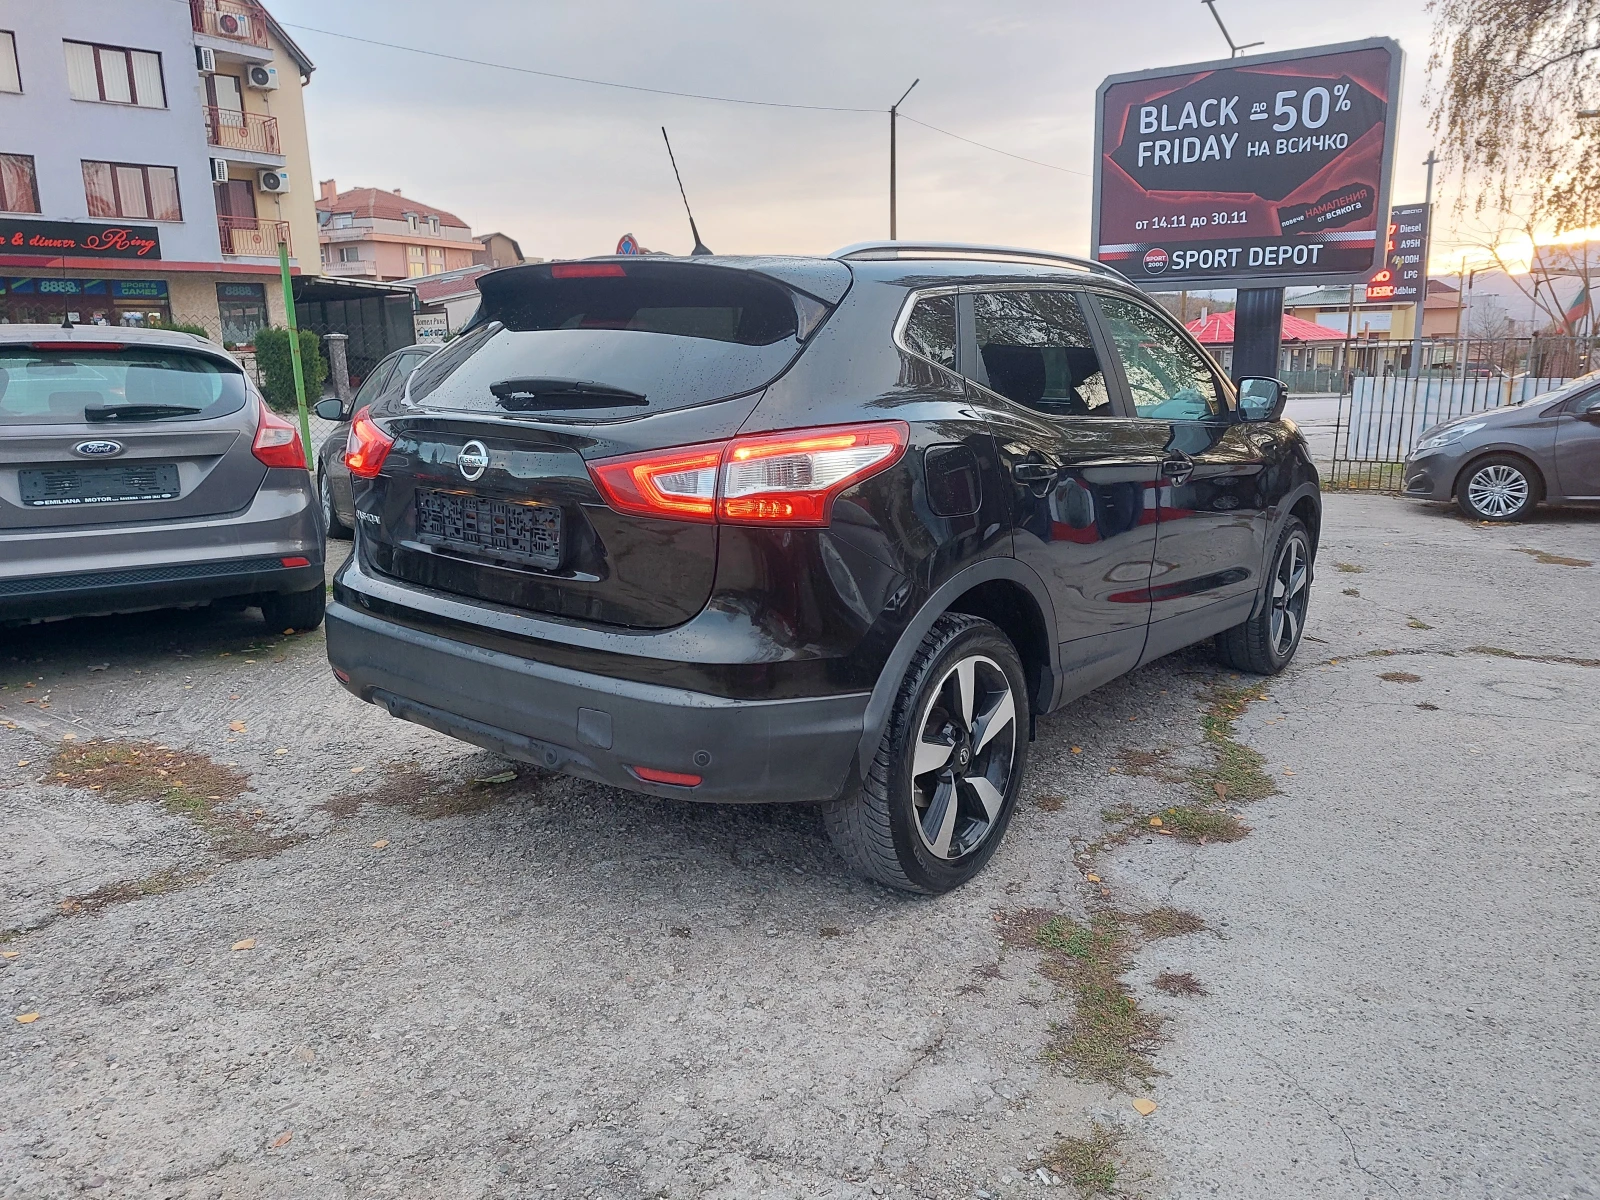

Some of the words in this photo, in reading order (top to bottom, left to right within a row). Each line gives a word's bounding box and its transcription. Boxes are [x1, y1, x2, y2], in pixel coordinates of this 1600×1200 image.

[1140, 96, 1240, 134] BLACK
[1251, 102, 1267, 113] до
[1138, 132, 1239, 167] FRIDAY
[1247, 141, 1270, 157] НА
[1276, 133, 1348, 155] ВСИЧКО
[1282, 215, 1305, 228] повече
[1305, 189, 1367, 218] НАМАЛЕНИЯ
[1135, 220, 1149, 231] от
[1152, 215, 1187, 229] 14.11
[1190, 216, 1208, 228] до
[1211, 210, 1248, 225] 30.11
[1317, 215, 1326, 223] от
[1400, 223, 1422, 233] Diesel
[11, 231, 24, 246] &
[29, 234, 77, 248] dinner
[80, 228, 156, 256] Ring
[1145, 255, 1166, 263] SPORT
[1172, 248, 1243, 270] SPORT
[1248, 244, 1324, 267] DEPOT
[1404, 270, 1418, 279] LPG
[1393, 285, 1417, 295] Adblue
[86, 442, 111, 454] Ford
